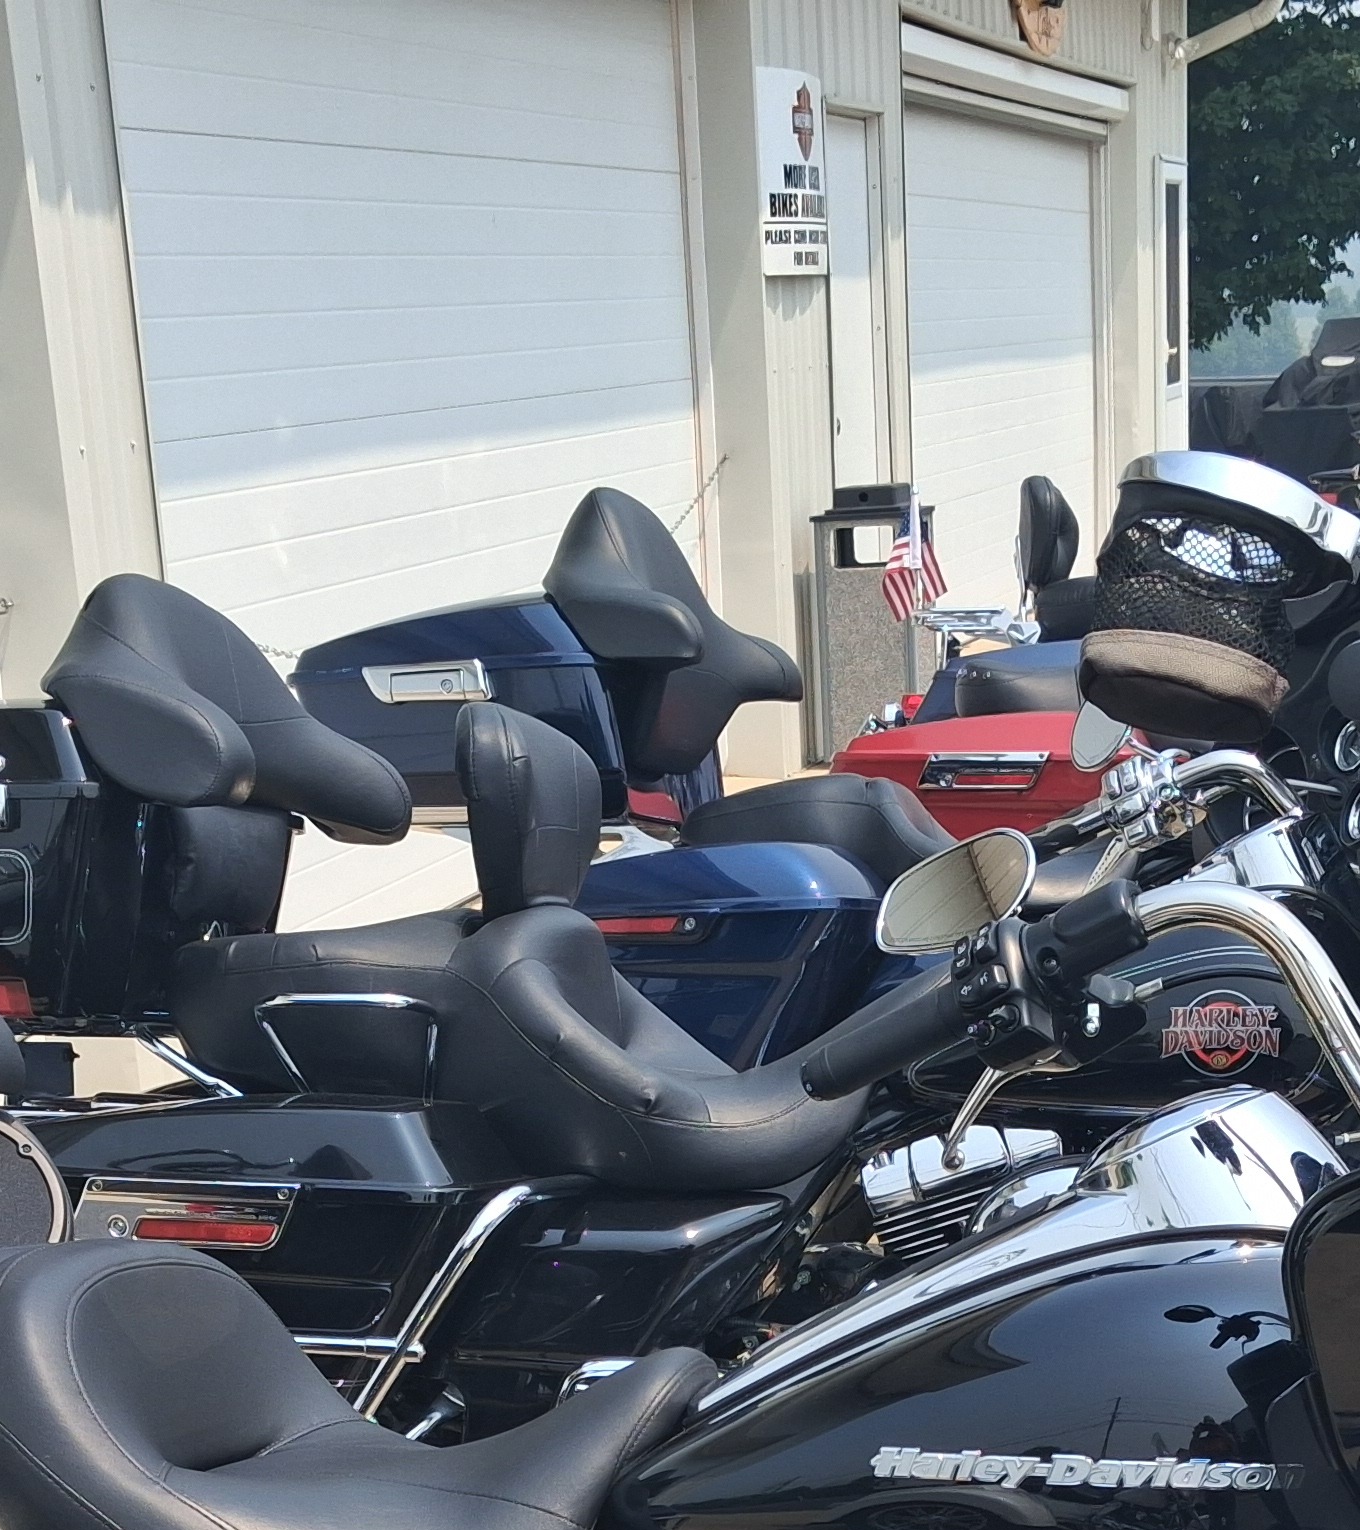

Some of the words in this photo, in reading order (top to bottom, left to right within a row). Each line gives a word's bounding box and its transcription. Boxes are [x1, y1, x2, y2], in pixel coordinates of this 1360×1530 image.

[769, 193, 799, 218] BIKES
[764, 229, 792, 245] PLEASE
[1169, 1006, 1278, 1029] HARLEY-
[1160, 1028, 1282, 1059] DAVIDSON
[870, 1446, 1305, 1490] Harley-Davidson
